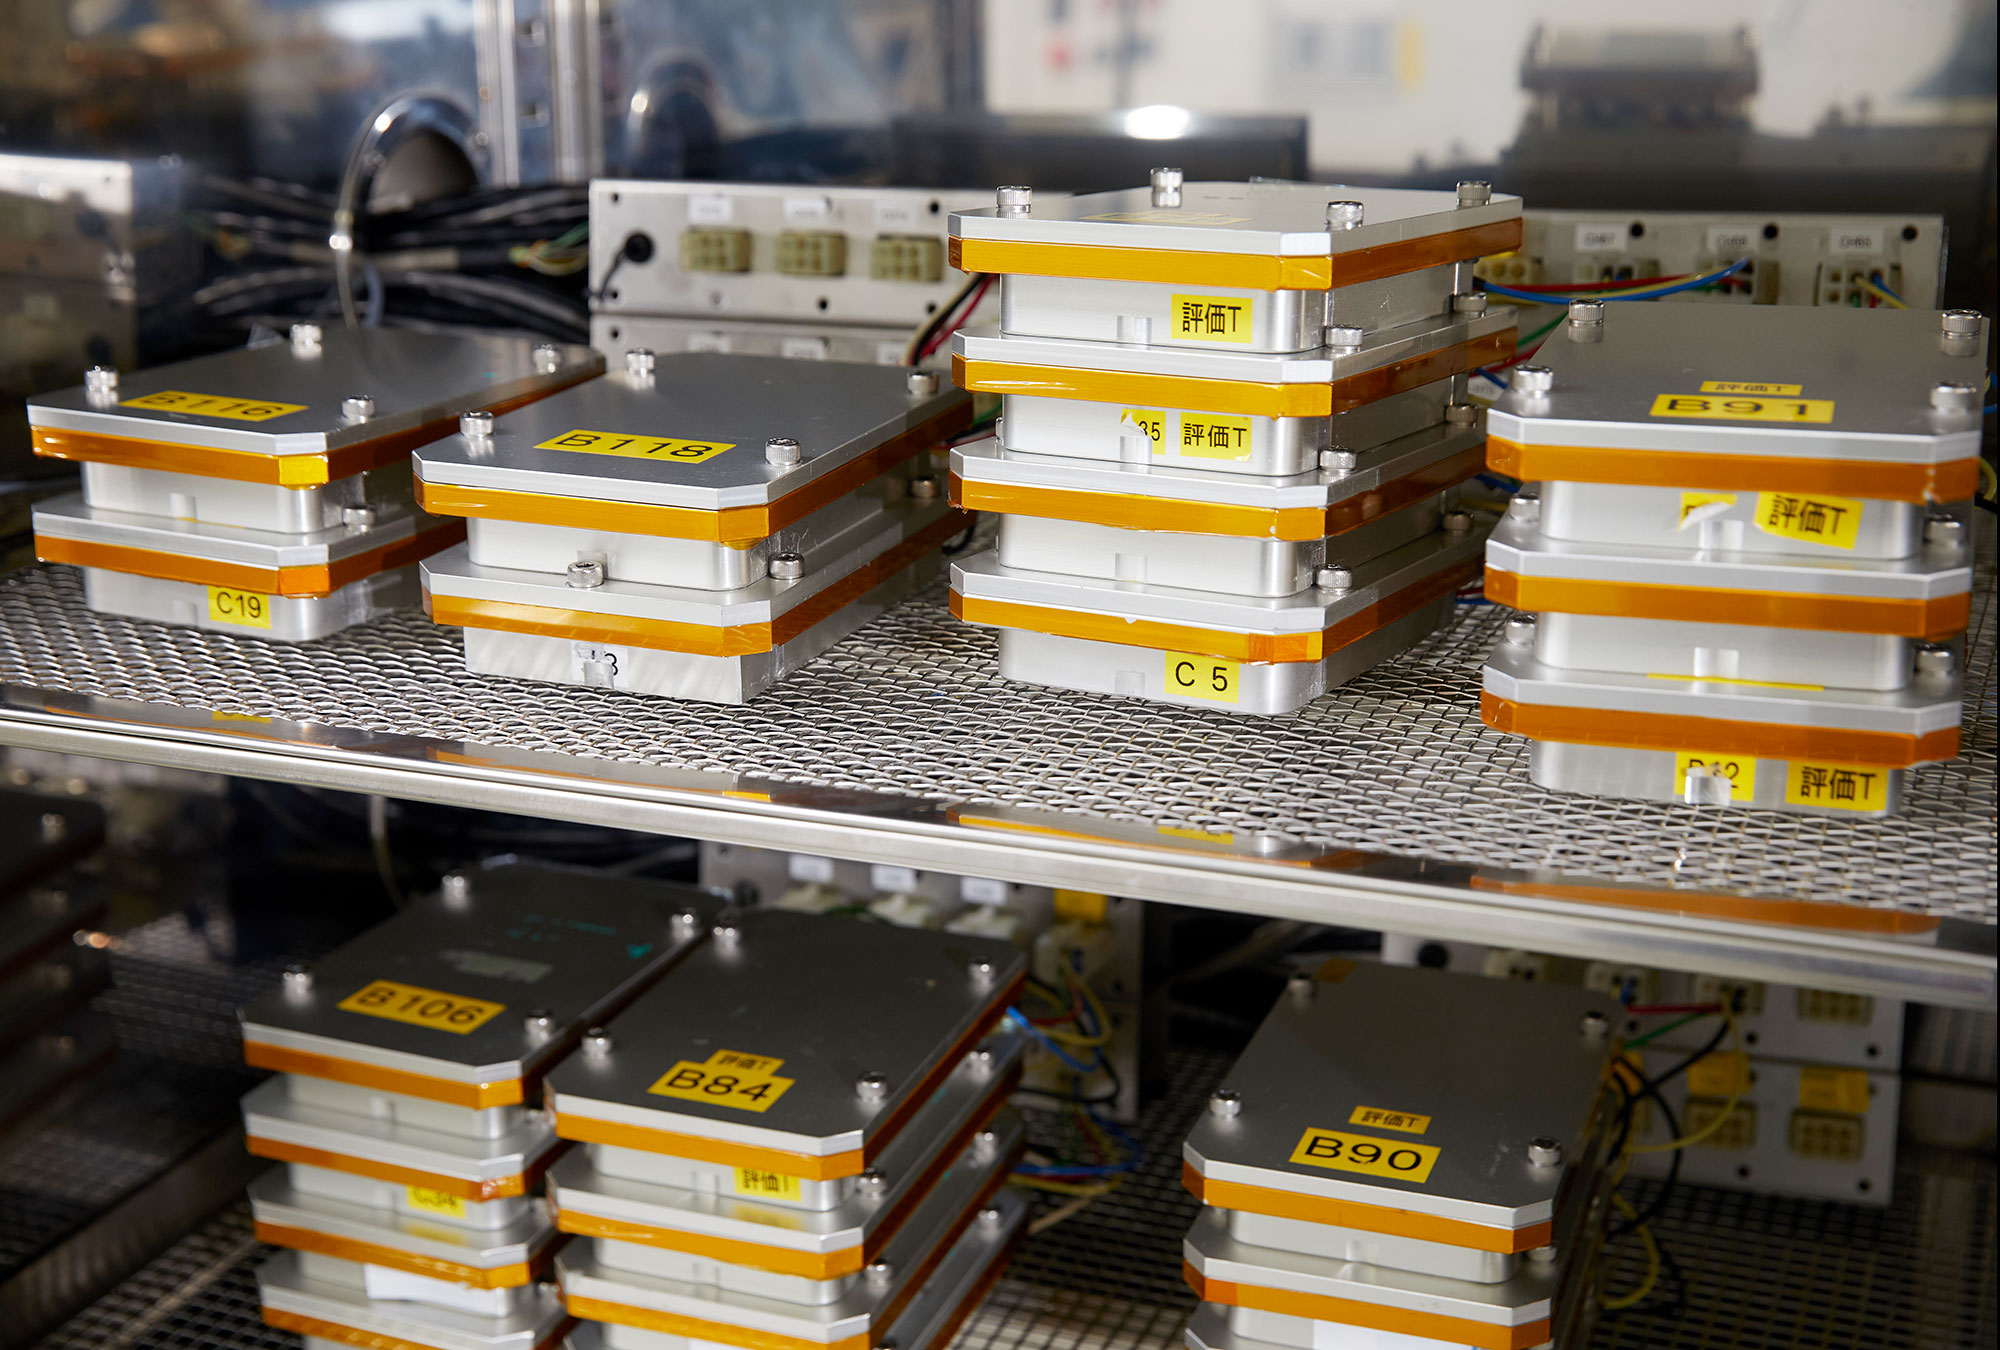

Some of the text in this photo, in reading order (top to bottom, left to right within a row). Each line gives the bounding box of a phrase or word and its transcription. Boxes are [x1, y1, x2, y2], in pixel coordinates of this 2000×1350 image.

[1182, 302, 1242, 335] 評価T
[141, 393, 283, 416] B116
[1667, 398, 1809, 417] B91
[555, 434, 713, 458] B118
[1183, 423, 1247, 448] 評価T
[1768, 494, 1848, 535] 評価T
[216, 591, 261, 618] C19
[1801, 766, 1877, 801] 評価T
[357, 986, 485, 1025] B106
[666, 1068, 772, 1102] B84
[1361, 1110, 1420, 1128] 評価T
[1304, 1135, 1422, 1171] B90
